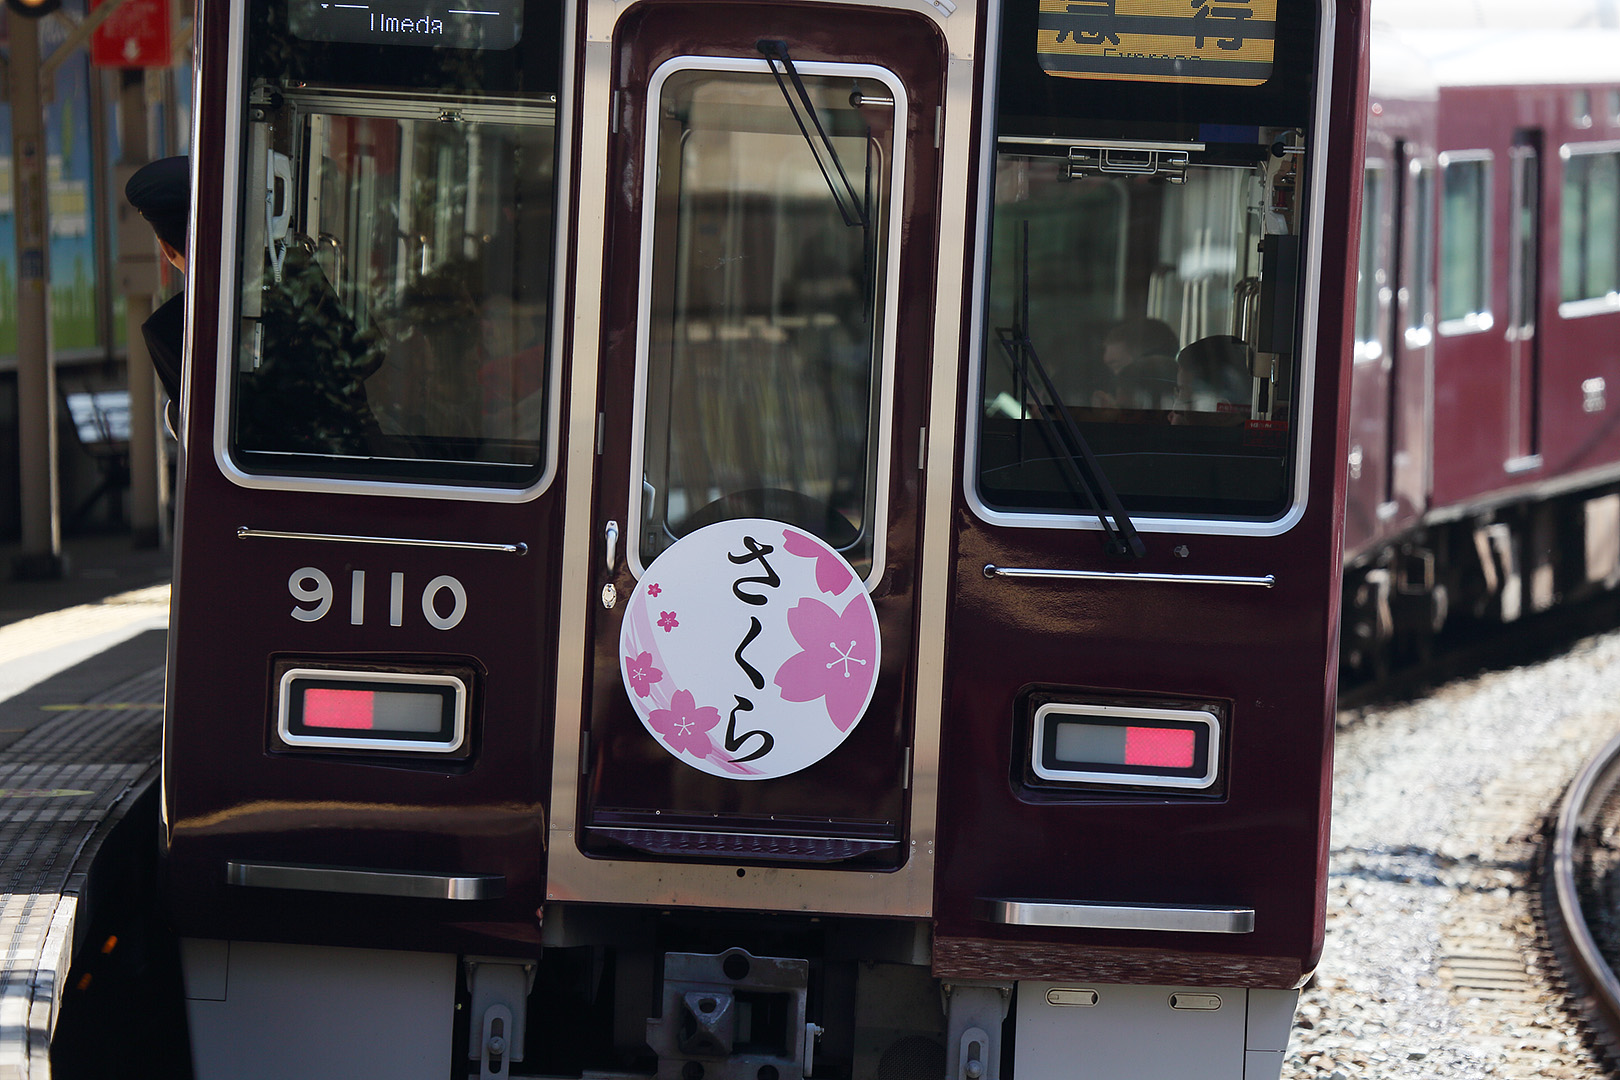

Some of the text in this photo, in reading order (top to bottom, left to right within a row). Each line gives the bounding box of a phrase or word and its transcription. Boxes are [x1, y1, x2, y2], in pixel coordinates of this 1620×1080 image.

[288, 566, 468, 631] 9110
[725, 535, 781, 763] さくら
